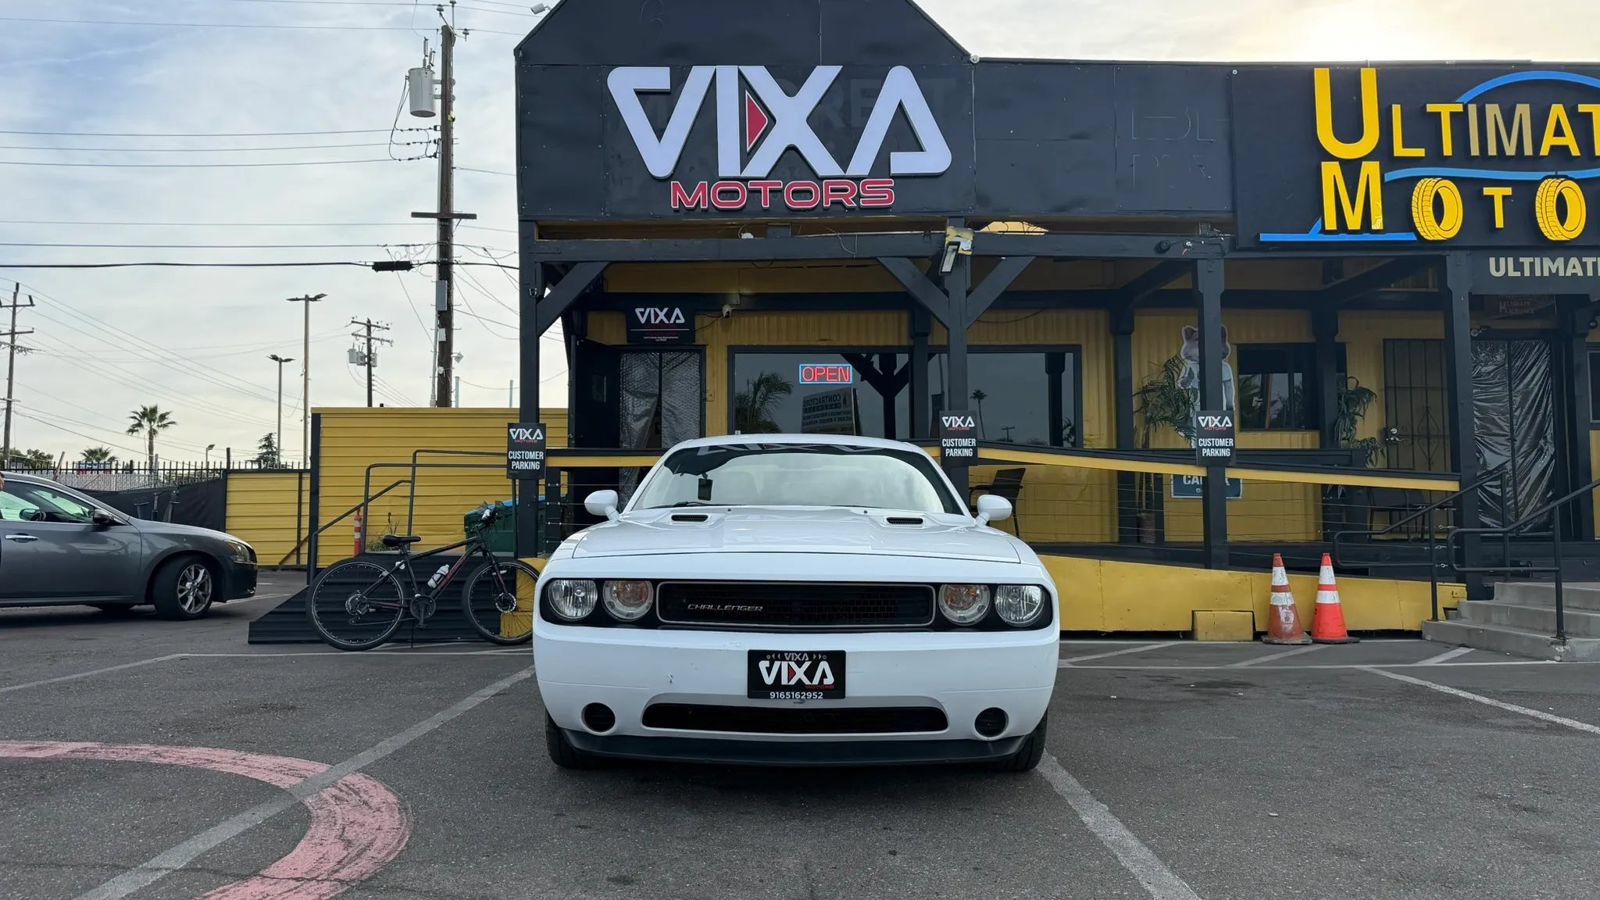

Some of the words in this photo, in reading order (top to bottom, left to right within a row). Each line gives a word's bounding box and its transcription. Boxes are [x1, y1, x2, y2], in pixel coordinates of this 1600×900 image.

[607, 66, 952, 178] VIXA
[670, 179, 896, 211] MOTORS
[1488, 256, 1600, 277] ULTIMAT
[634, 307, 686, 324] VIXA
[802, 366, 850, 382] OPEN
[941, 416, 976, 428] VIXA
[1197, 415, 1232, 427] VIXA
[509, 428, 544, 440] VIXA
[942, 438, 976, 447] CUSTOMER
[1198, 438, 1234, 447] CUSTOMER
[508, 451, 544, 460] CUSTOMER
[945, 448, 973, 457] PARKING
[1202, 448, 1231, 457] PARKING
[511, 460, 541, 470] PARKING
[687, 603, 764, 612] CHALLENGER
[784, 652, 809, 661] VIXA
[758, 660, 835, 685] VIXA
[769, 691, 824, 700] 9165162952
